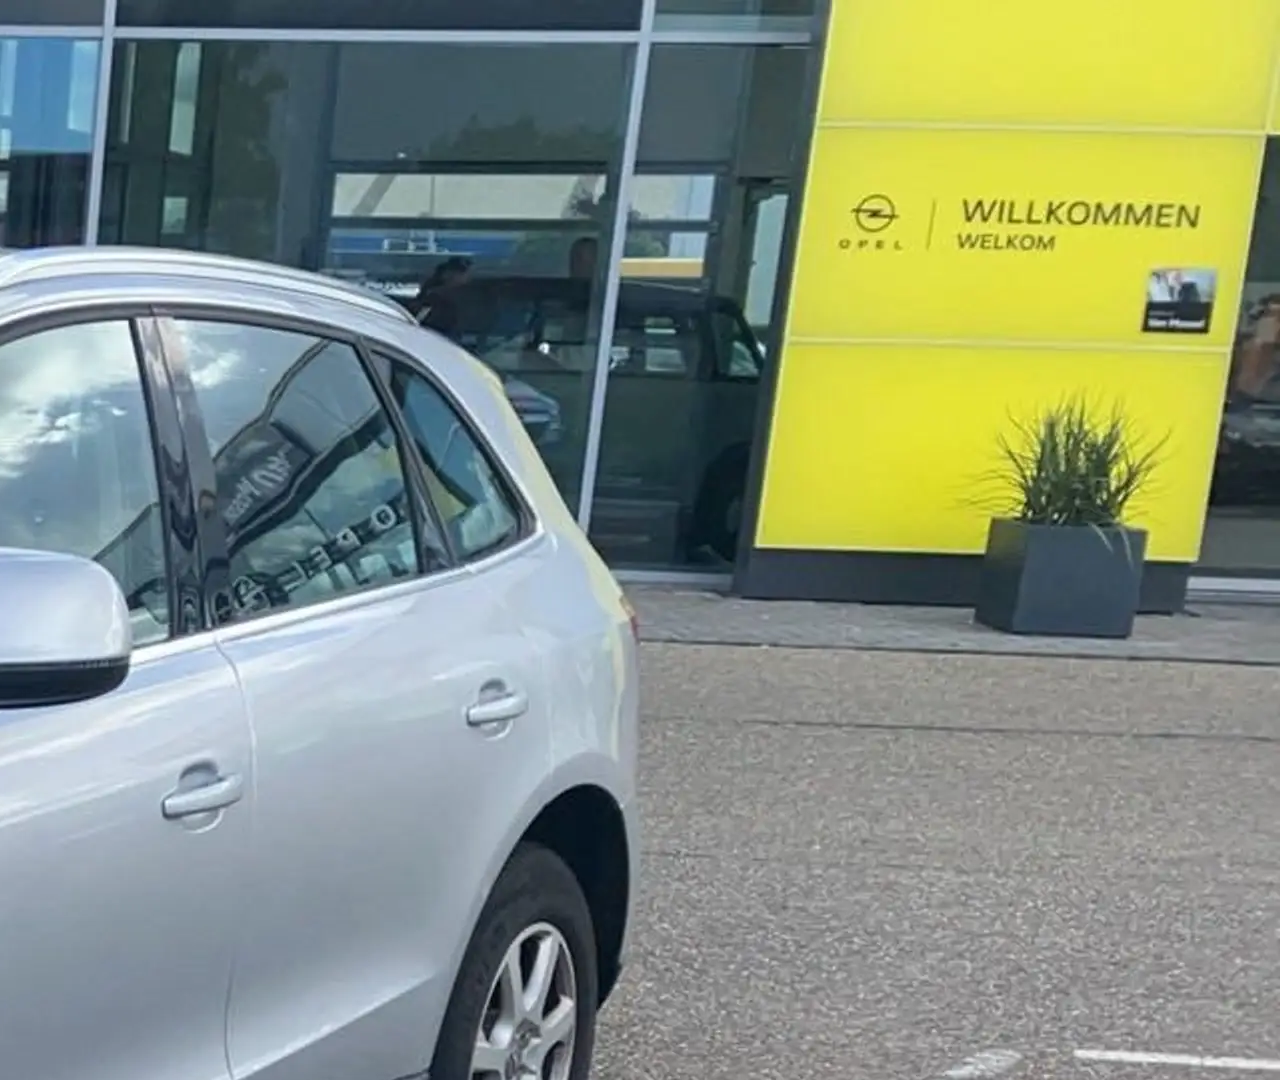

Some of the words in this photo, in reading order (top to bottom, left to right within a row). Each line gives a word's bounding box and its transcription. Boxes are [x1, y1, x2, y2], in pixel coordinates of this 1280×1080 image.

[961, 198, 1201, 230] WILLKOMMEN
[838, 238, 903, 251] OPEL
[956, 233, 1057, 251] WELKOM
